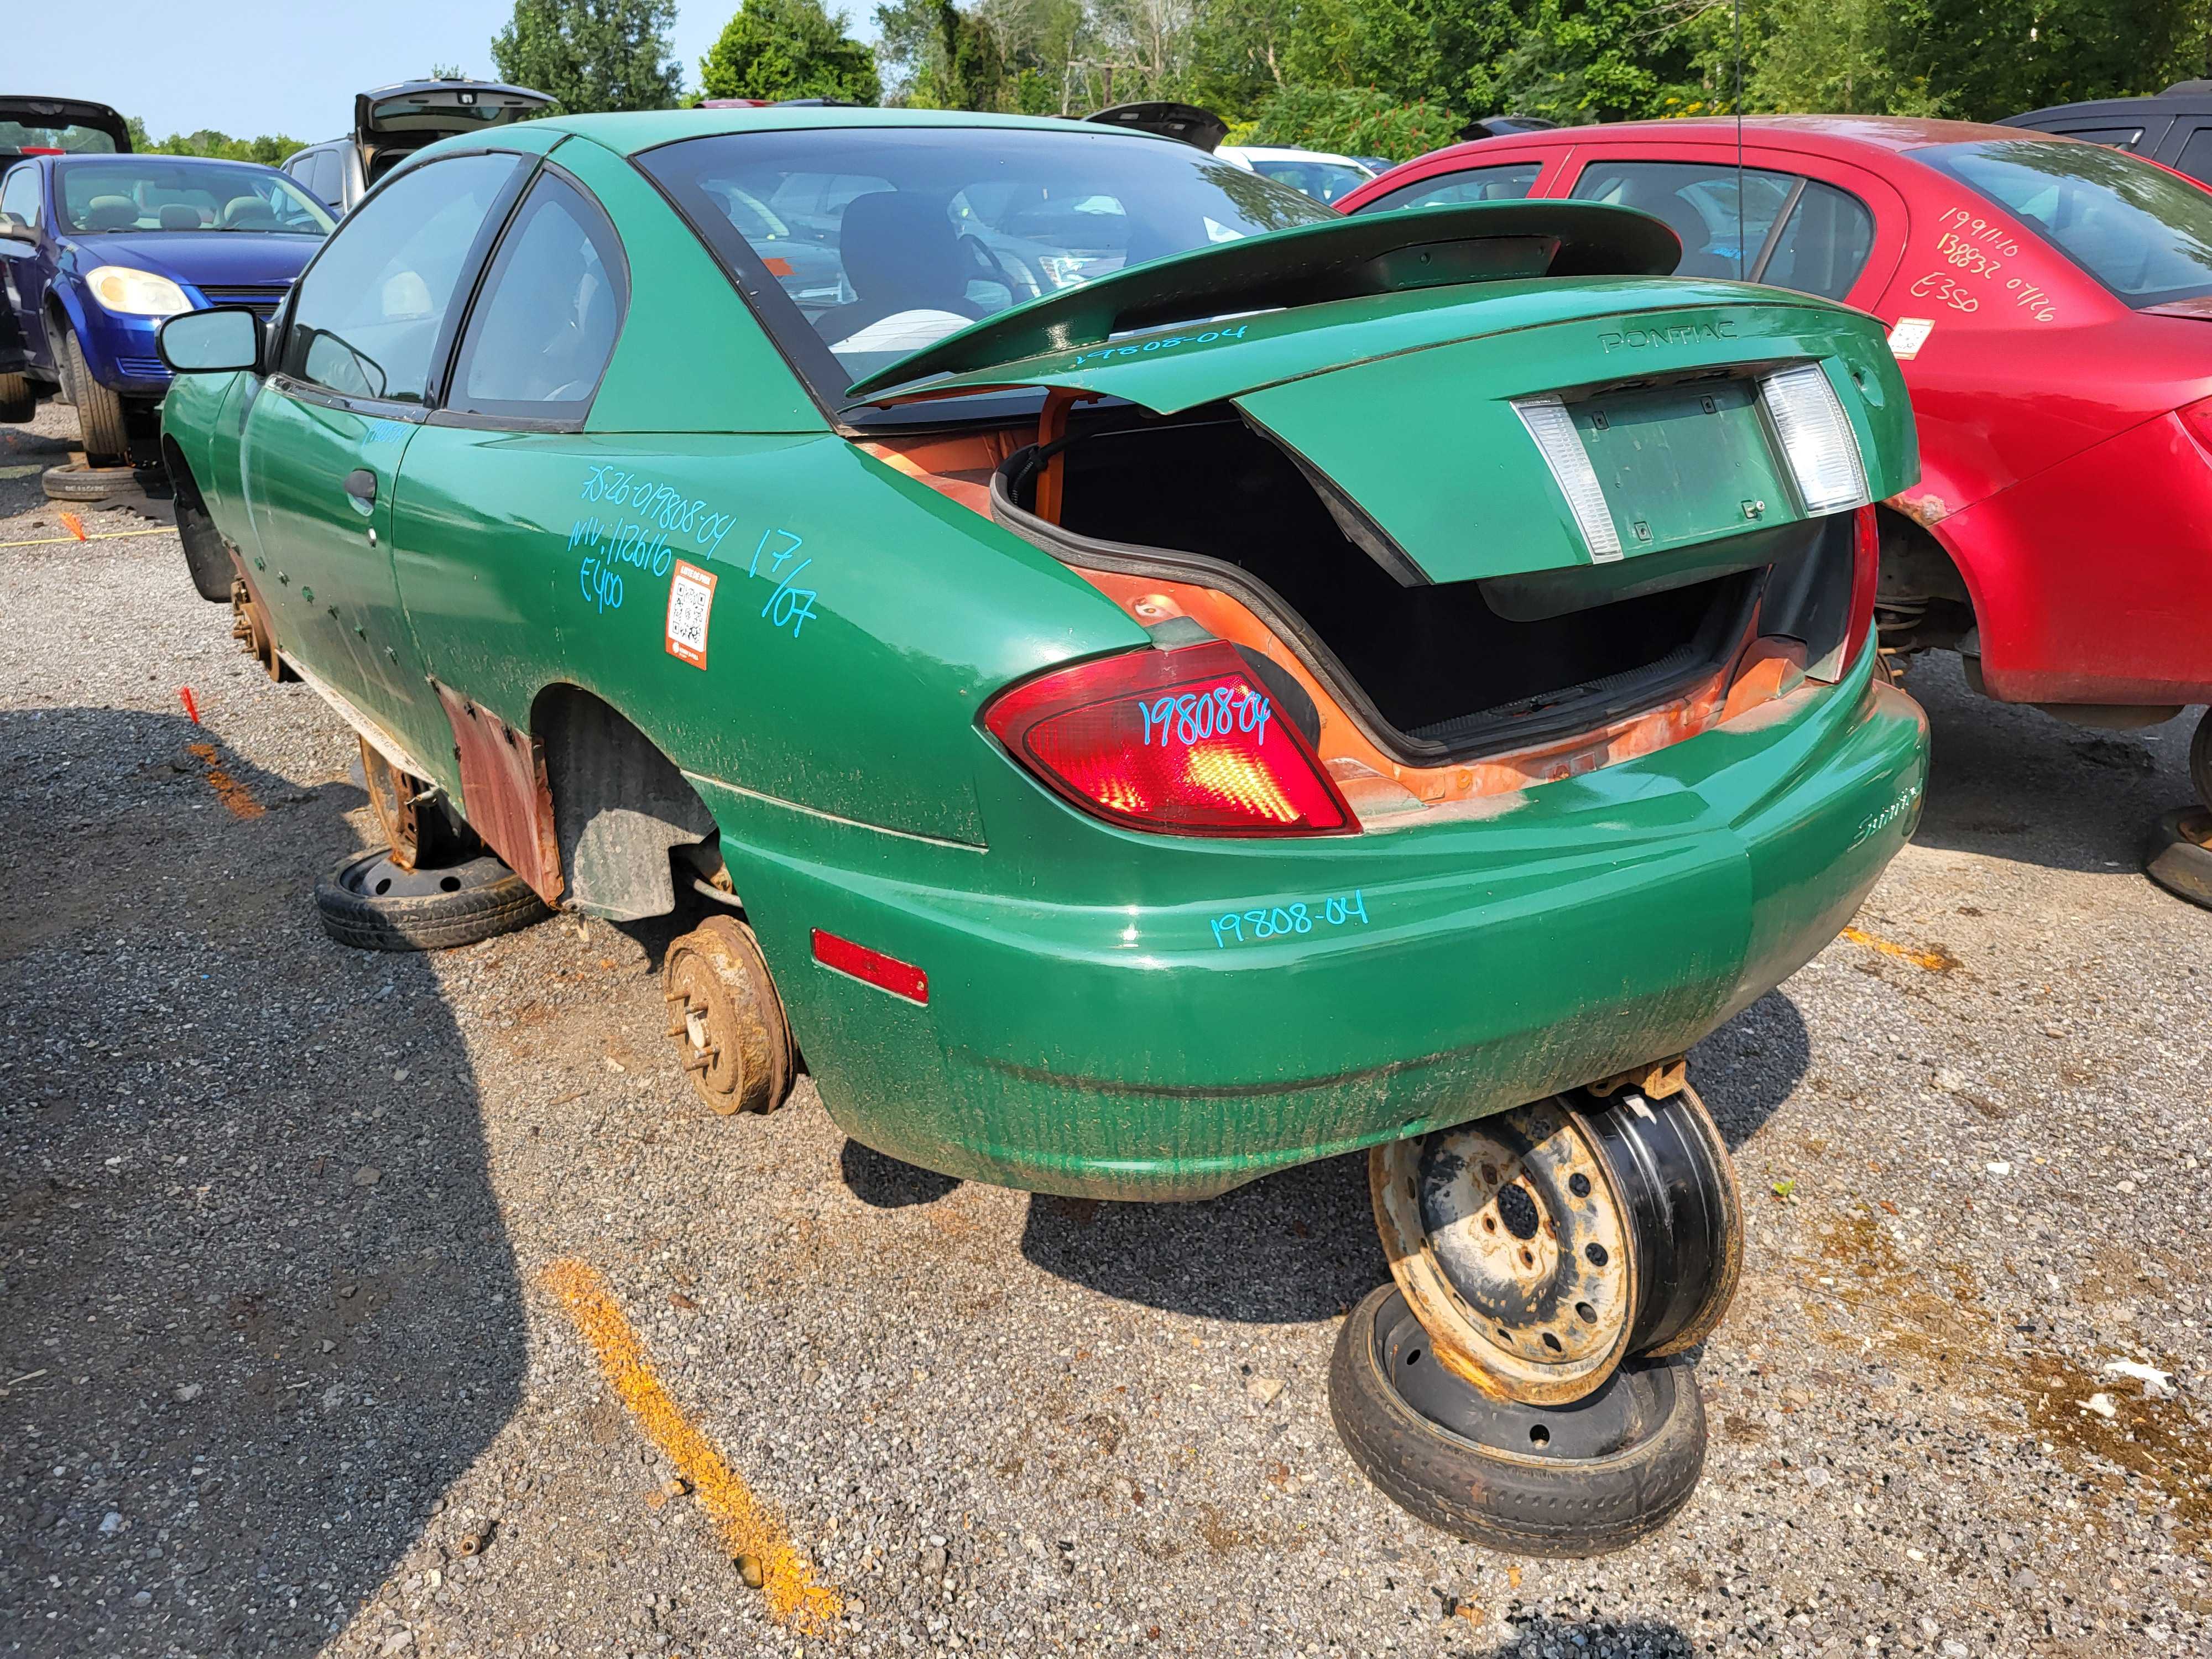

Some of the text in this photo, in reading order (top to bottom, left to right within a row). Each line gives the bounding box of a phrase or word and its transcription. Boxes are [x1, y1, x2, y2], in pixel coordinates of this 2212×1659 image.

[1938, 207, 2018, 257] 19911-10
[1937, 232, 2001, 279] 138832
[1910, 271, 1979, 312] E350
[2005, 278, 2057, 322] 07/26
[1075, 325, 1249, 365] 19808-04
[1597, 320, 1739, 353] PONTIAC
[1138, 687, 1271, 747] 19808-04
[1211, 889, 1369, 948] 19808-04
